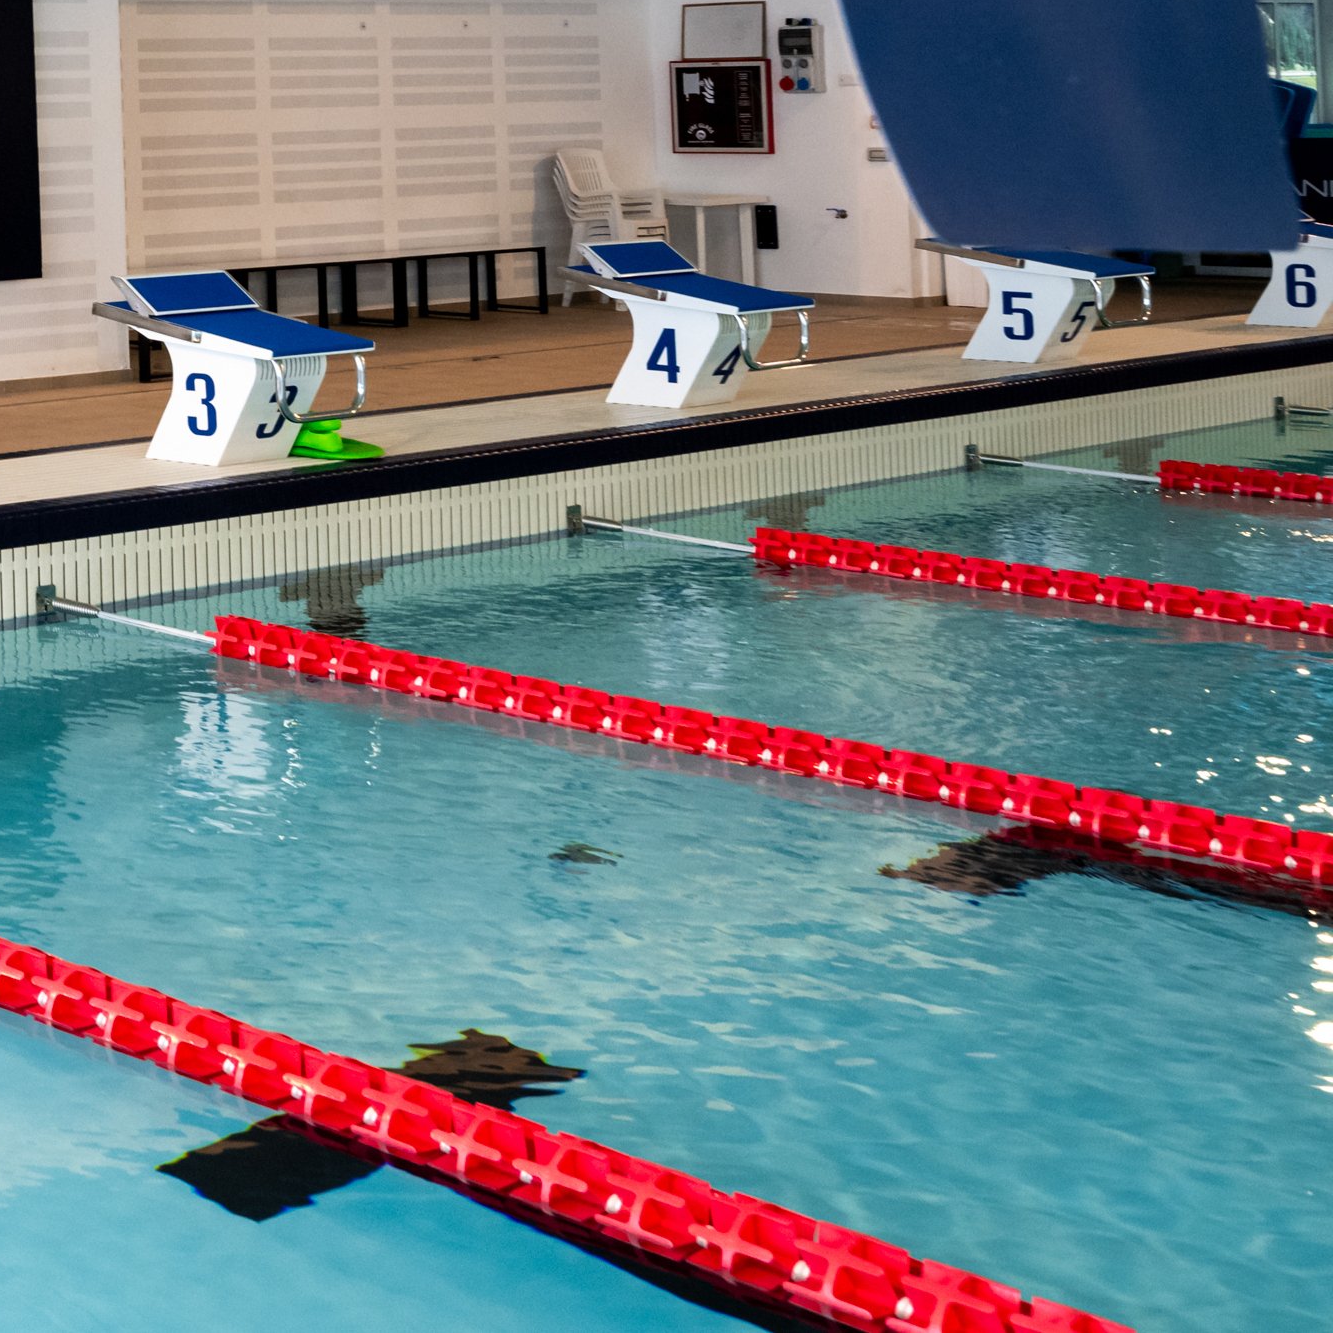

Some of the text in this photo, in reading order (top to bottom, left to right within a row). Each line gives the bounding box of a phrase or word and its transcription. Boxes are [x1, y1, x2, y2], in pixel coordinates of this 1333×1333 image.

[1285, 263, 1317, 308] 6
[1001, 290, 1035, 341] 5
[1060, 301, 1095, 344] 5
[646, 327, 681, 384] 4
[712, 344, 743, 385] 4
[185, 372, 218, 437] 3
[255, 385, 299, 439] 3
